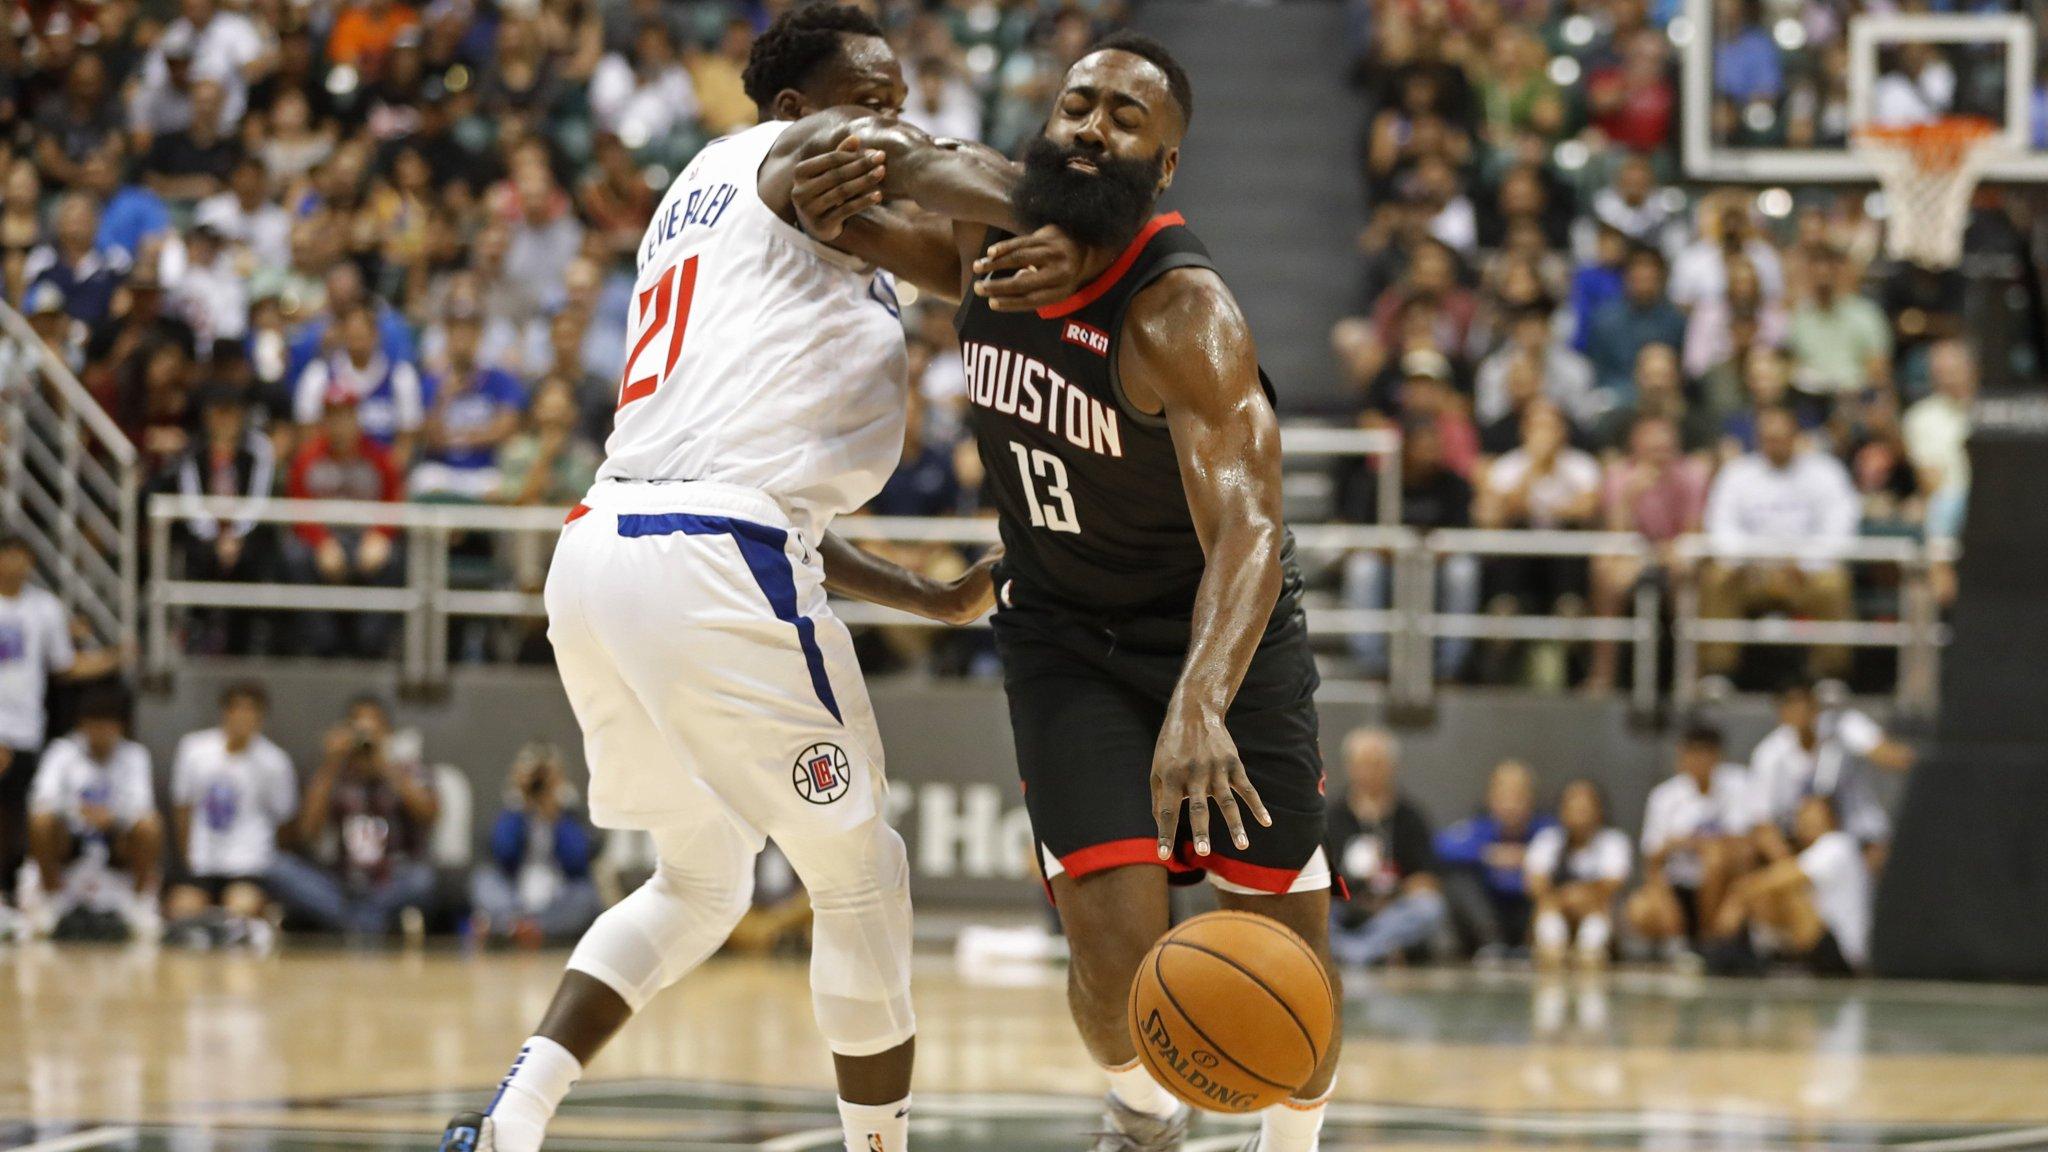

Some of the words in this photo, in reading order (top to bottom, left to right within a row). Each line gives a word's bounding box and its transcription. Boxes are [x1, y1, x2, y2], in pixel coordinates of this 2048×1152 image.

[640, 183, 738, 272] EVERLEY
[616, 254, 699, 412] 21
[964, 341, 1122, 457] HOUSTON
[1009, 440, 1081, 534] 13
[1140, 1008, 1259, 1107] SPALDING
